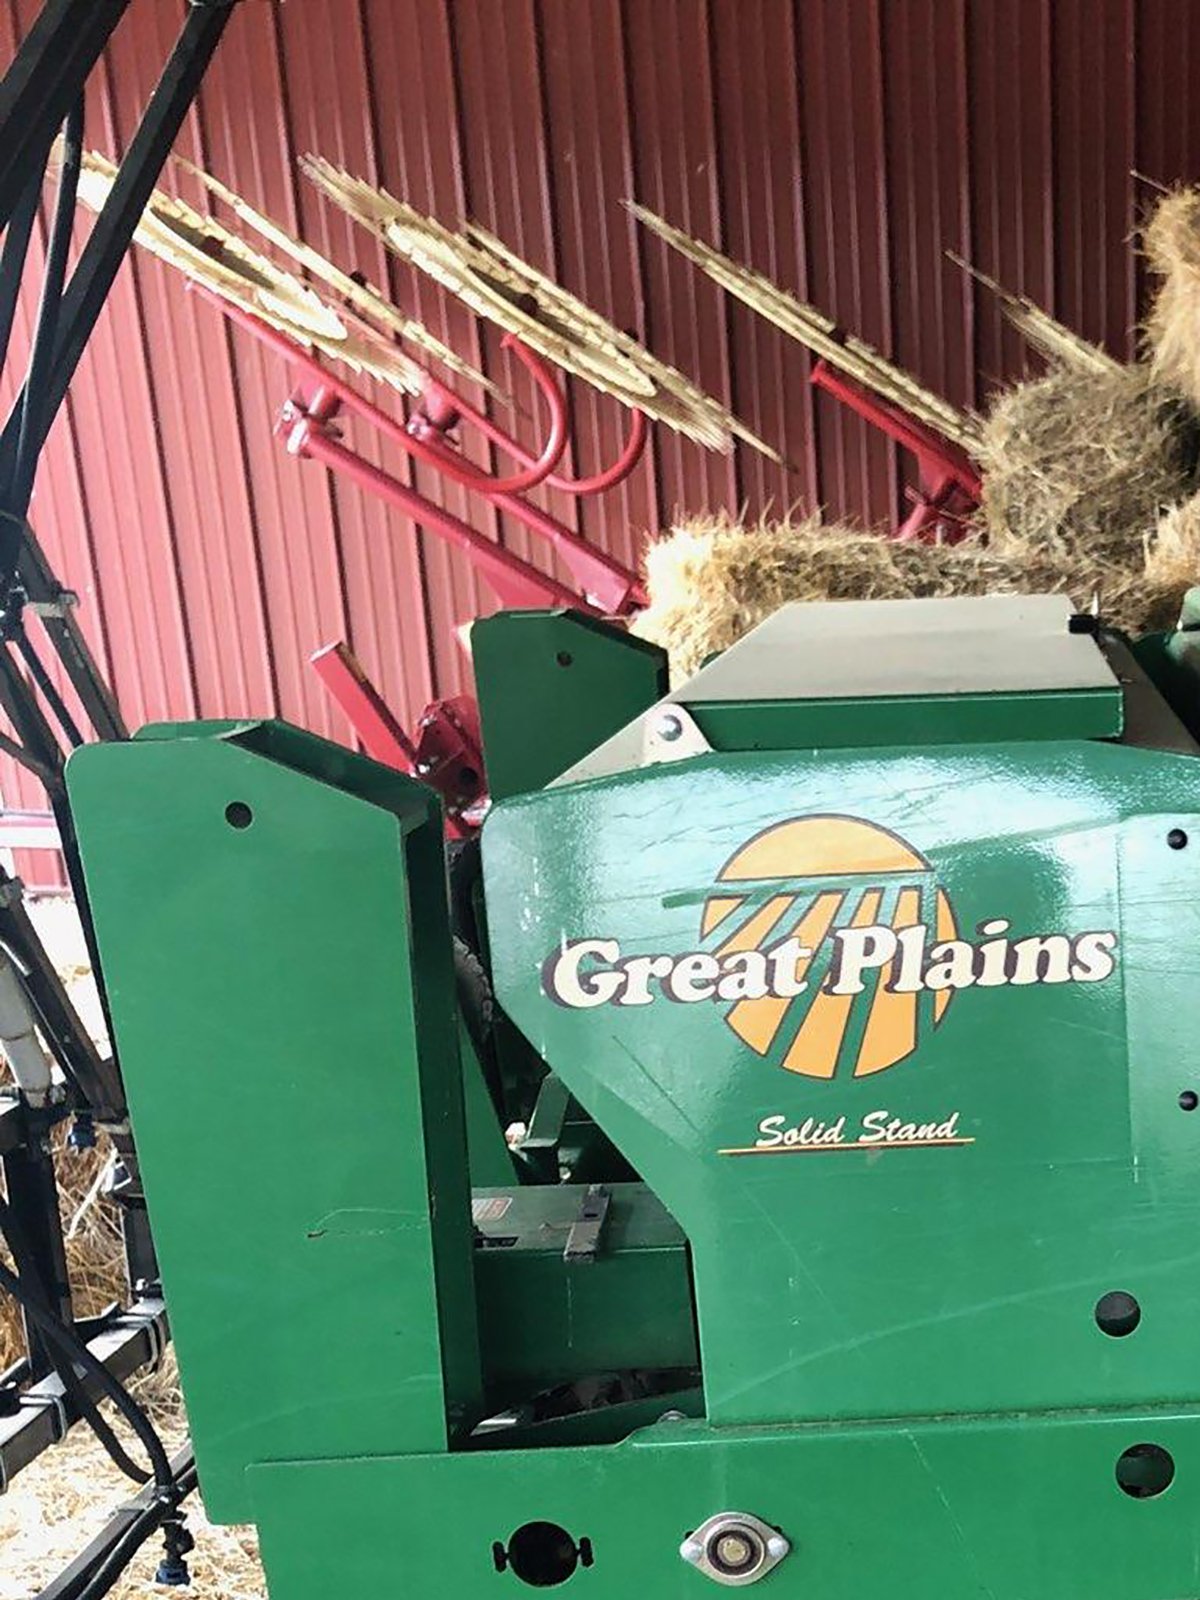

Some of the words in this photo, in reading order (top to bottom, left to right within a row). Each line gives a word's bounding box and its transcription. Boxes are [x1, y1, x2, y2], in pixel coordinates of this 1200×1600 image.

[542, 936, 816, 1009] Great
[825, 918, 1118, 997] Plains
[755, 1112, 846, 1148] Solid
[858, 1111, 959, 1145] Stand
